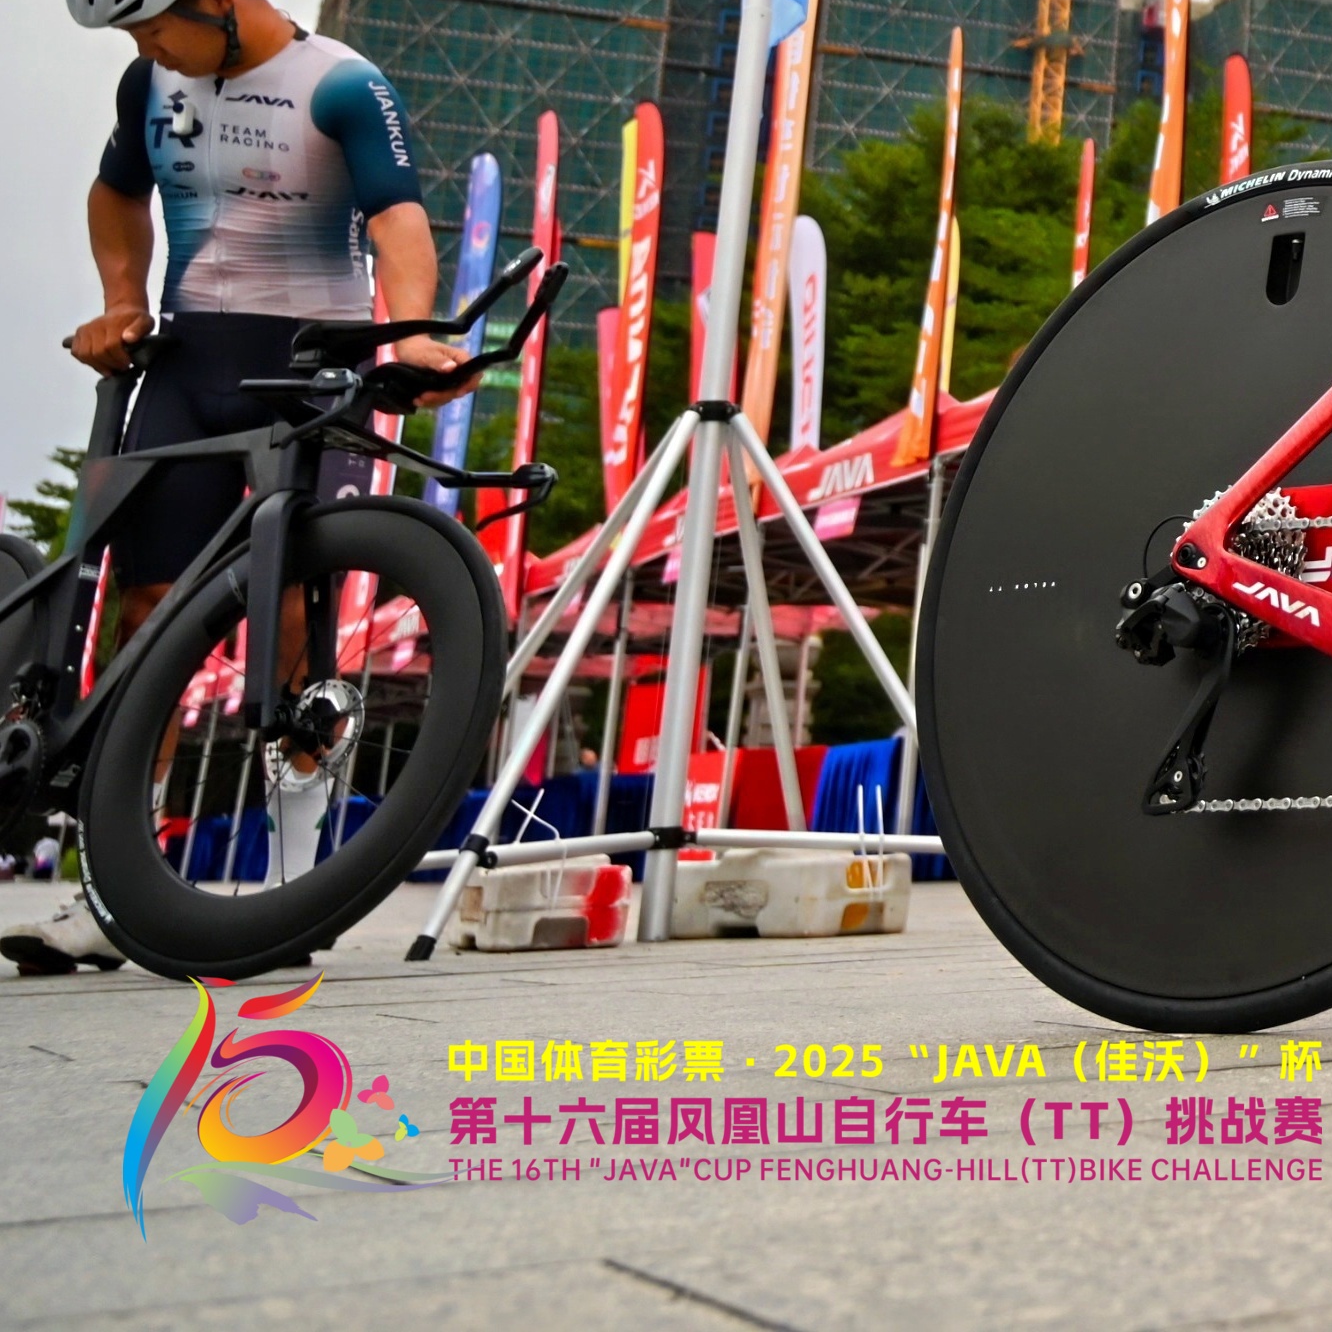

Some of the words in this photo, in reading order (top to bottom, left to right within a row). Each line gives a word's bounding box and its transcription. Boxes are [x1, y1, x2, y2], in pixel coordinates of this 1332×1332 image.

[225, 94, 295, 109] JAVA
[220, 124, 267, 138] TEAM
[368, 81, 411, 168] JIANKUN
[220, 134, 290, 152] RACING
[1220, 171, 1285, 199] MICHELIN
[807, 452, 874, 502] JAVA
[1233, 581, 1320, 627] JAVA
